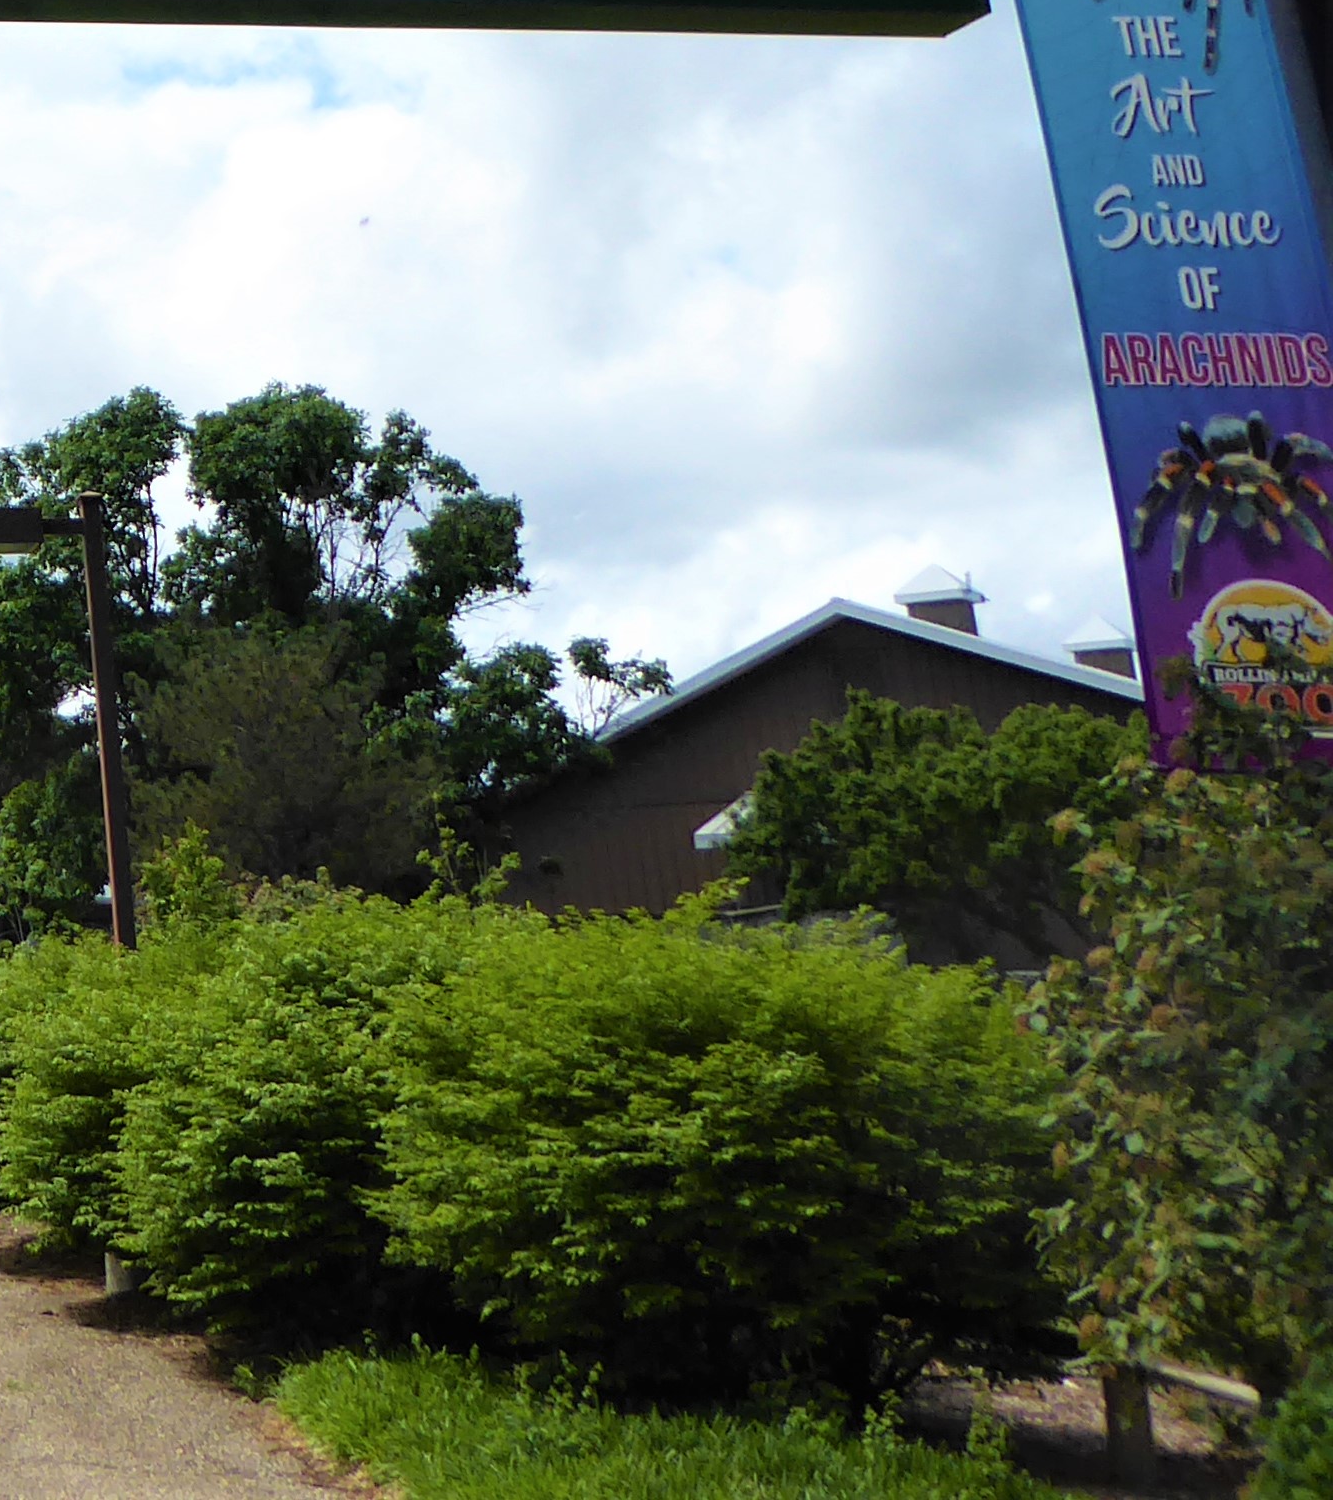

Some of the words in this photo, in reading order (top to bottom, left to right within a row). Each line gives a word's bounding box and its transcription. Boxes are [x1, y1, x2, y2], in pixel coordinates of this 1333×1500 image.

[1112, 16, 1183, 57] THE
[1111, 72, 1215, 137] Art
[1151, 154, 1204, 187] AND
[1094, 183, 1282, 250] Science
[1178, 265, 1221, 310] OF
[1102, 332, 1333, 387] ARACHNIDS
[1215, 668, 1290, 682] ROLLIN
